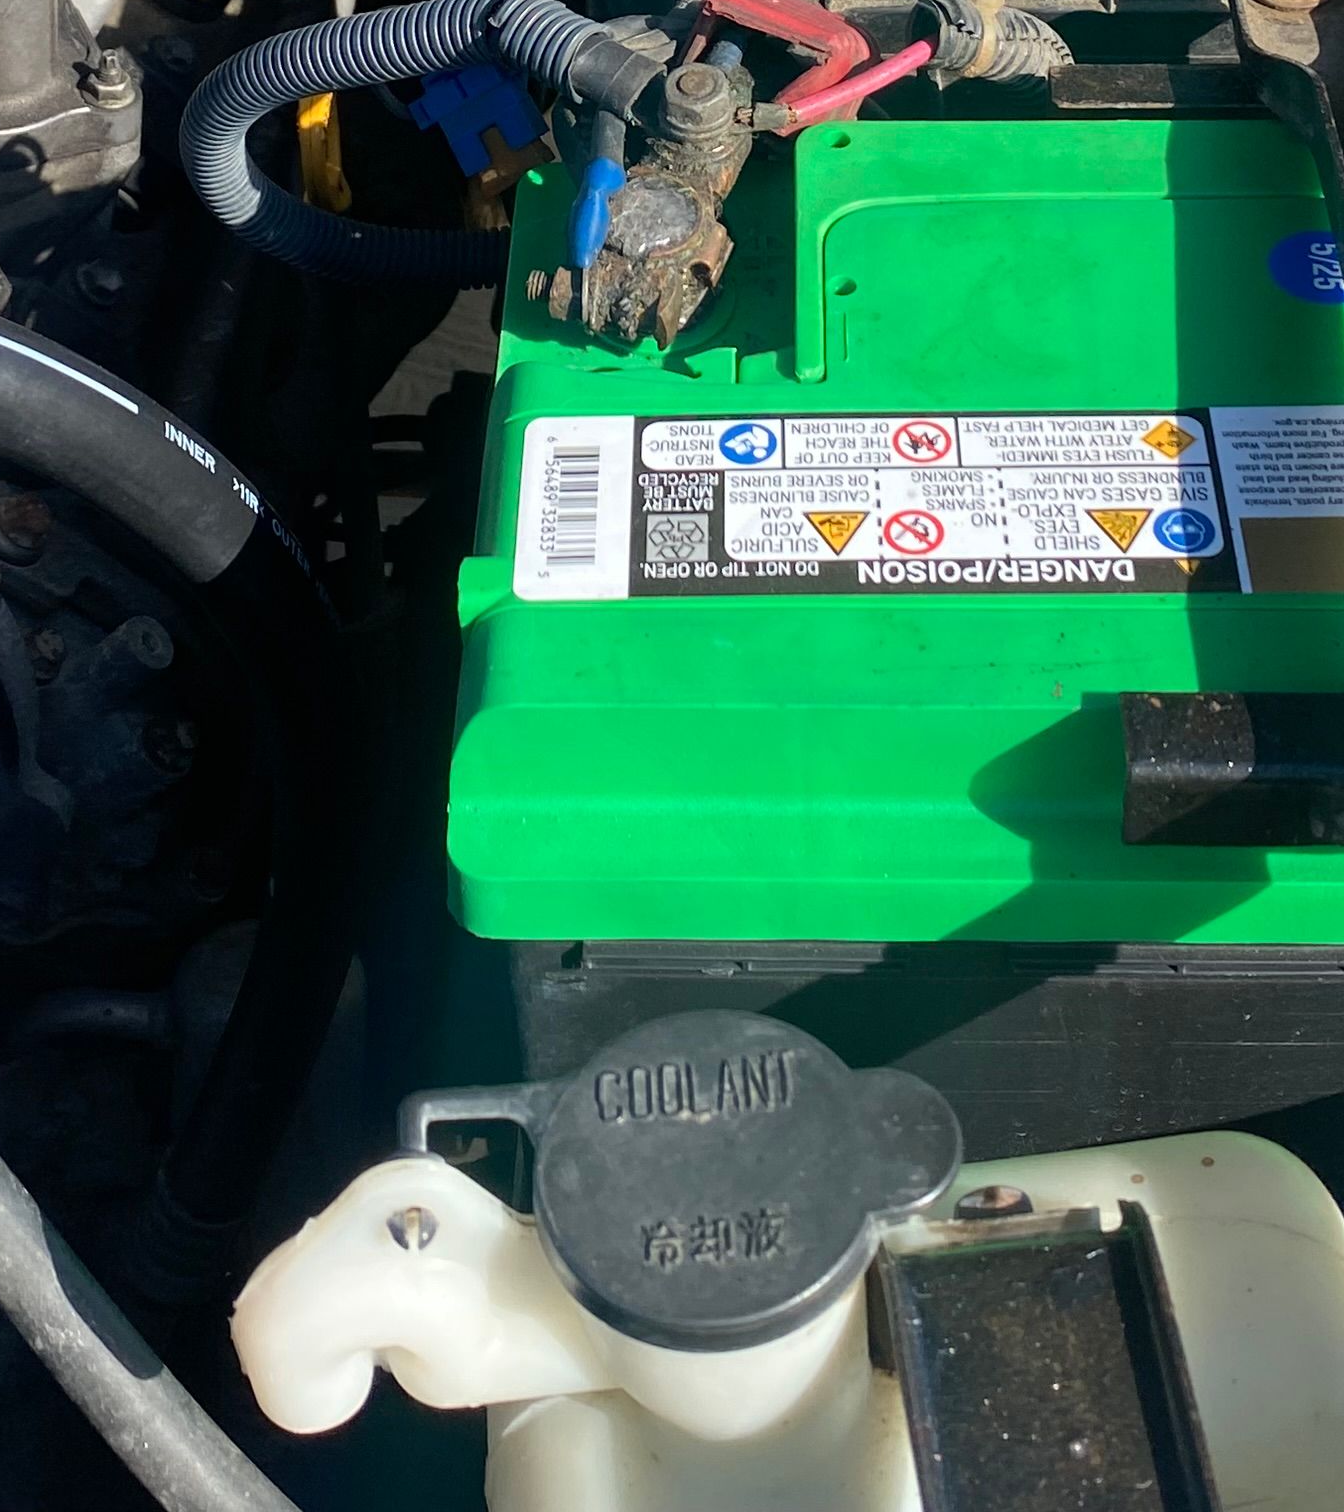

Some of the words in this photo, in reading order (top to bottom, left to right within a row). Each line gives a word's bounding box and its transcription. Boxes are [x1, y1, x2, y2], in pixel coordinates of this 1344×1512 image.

[666, 425, 714, 436] TIONS.
[787, 423, 866, 434] CHILDREN.
[870, 422, 889, 433] OF
[960, 421, 1000, 433] FAST.
[1005, 420, 1043, 432] HELP
[1047, 420, 1116, 432] MEDICAL
[1121, 420, 1150, 432] GET
[646, 440, 714, 451] INSTRUC-
[806, 438, 856, 448] REACH
[860, 438, 890, 448] THE
[985, 436, 1040, 448] WATER.
[1045, 436, 1083, 448] WITH
[1087, 435, 1133, 447] ATELY
[164, 421, 216, 474] INNER
[676, 454, 714, 465] READ
[794, 452, 809, 464] OF
[814, 452, 845, 463] OUT
[849, 452, 891, 463] KEEP
[996, 450, 1058, 462] IMMEDI-
[1063, 450, 1100, 461] EYES
[1105, 449, 1154, 461] FLUSH
[544, 460, 559, 500] 56489
[638, 472, 718, 486] RECYCLED
[727, 476, 782, 487] BURNS.
[787, 476, 844, 487] SEVERE
[848, 476, 868, 487] OR
[910, 471, 983, 482] SMOKING
[1030, 472, 1087, 484] INJURY.
[1093, 472, 1113, 484] OR
[1118, 472, 1205, 484] BLINDNESS
[644, 486, 664, 498] BE
[670, 486, 712, 498] MUST
[820, 490, 869, 502] CAUSE
[922, 484, 984, 496] FLAMES
[1007, 488, 1058, 500] CAUSE
[1063, 488, 1096, 500] CAN
[1102, 488, 1161, 500] GASES
[1168, 487, 1208, 500] SIVE
[729, 491, 815, 502] BLINDNESS
[642, 498, 714, 510] BATTERY
[925, 499, 986, 510] SPARKS
[1012, 503, 1076, 517] EXPLO-
[760, 506, 792, 518] CAN
[971, 513, 997, 526] NO
[540, 508, 556, 552] 32833
[762, 522, 804, 535] ACID
[1029, 519, 1079, 533] EYES.
[731, 538, 818, 552] SULFURIC
[1034, 536, 1100, 550] SHIELD
[639, 563, 690, 578] OPEN.
[694, 562, 718, 577] OR
[722, 562, 748, 576] TIP
[756, 561, 789, 576] NOT
[796, 562, 819, 576] DO
[858, 559, 1136, 583] DANGER/POISON
[595, 1050, 795, 1123] COOLANT
[641, 1203, 788, 1273] 冷却液
